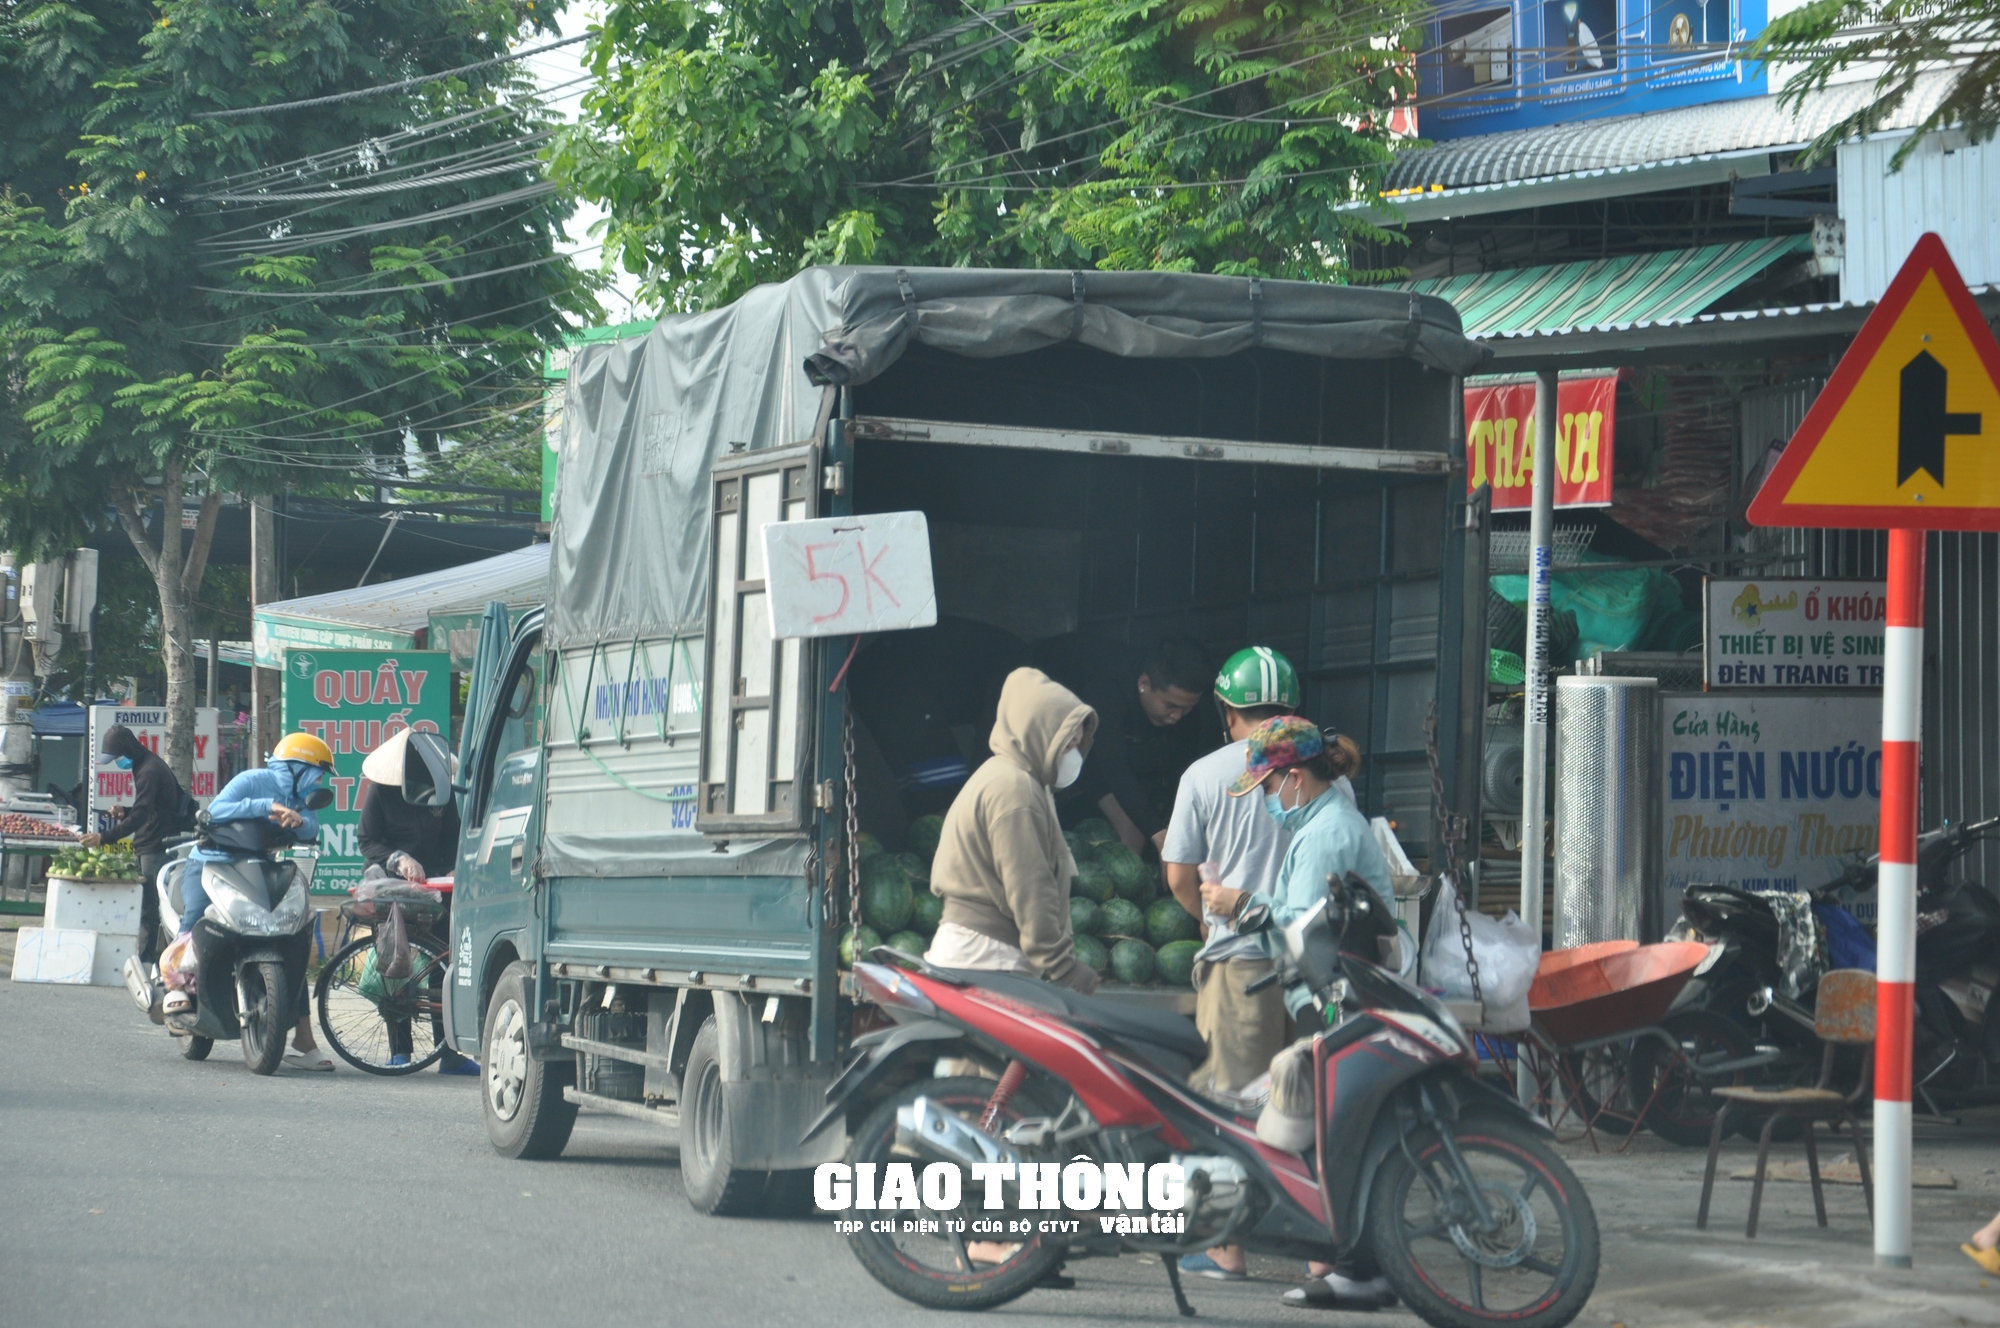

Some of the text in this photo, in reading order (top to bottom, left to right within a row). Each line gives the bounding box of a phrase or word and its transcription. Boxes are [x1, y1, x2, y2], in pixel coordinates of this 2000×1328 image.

[805, 540, 901, 624] 5K
[1805, 585, 1821, 621] Ổ
[1719, 629, 1776, 655] THIẾT
[1783, 635, 1803, 660] BỊ
[1810, 631, 1835, 660] VỆ
[313, 658, 428, 709] QUẦY
[1718, 660, 1766, 685] ĐÈN
[1773, 664, 1849, 685] TRANG
[115, 712, 160, 723] FAMILY
[1673, 710, 1760, 744] Cửa Hàng
[1669, 740, 1883, 812] ĐIỆN NƯỚC
[1668, 814, 1788, 870] Phương
